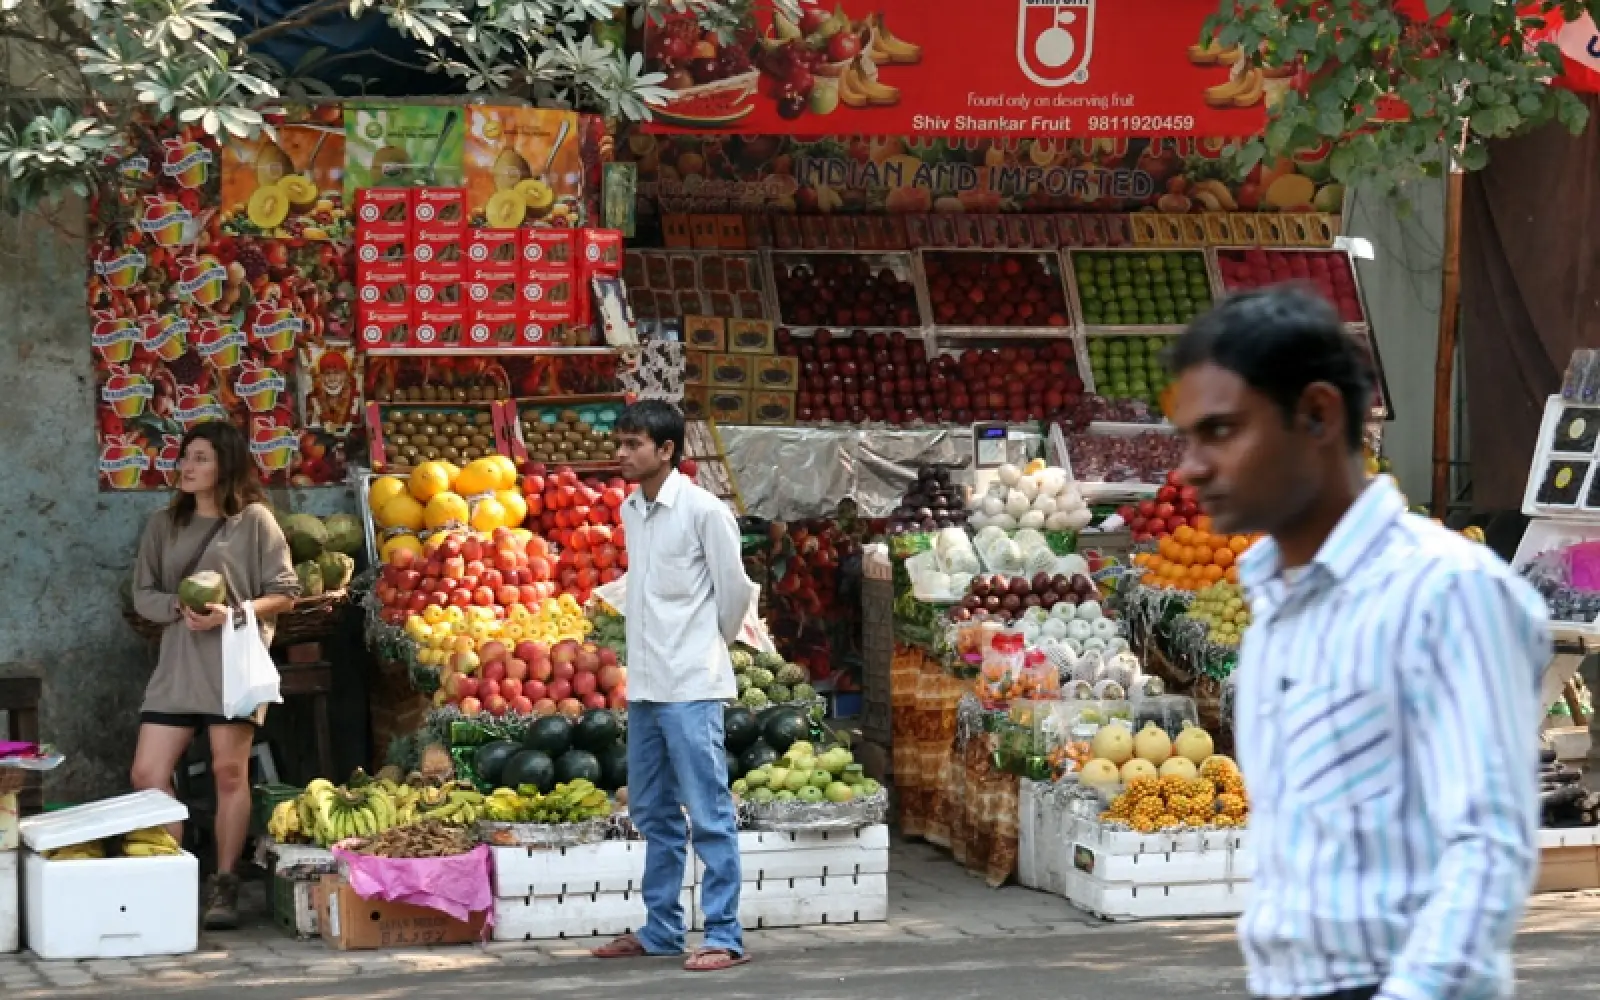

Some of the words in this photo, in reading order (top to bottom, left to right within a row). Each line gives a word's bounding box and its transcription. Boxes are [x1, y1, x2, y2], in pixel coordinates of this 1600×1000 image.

[967, 92, 1004, 107] Found
[1005, 92, 1031, 110] only
[1052, 92, 1109, 110] deserving
[1111, 92, 1135, 107] fruit
[912, 114, 951, 131] Shiv
[955, 115, 1028, 131] Shankar
[1031, 115, 1072, 131] Fruit
[1087, 115, 1194, 131] 9811920459
[796, 158, 904, 189] INDIAN
[911, 161, 979, 191] AND
[987, 165, 1154, 198] IMPORTED
